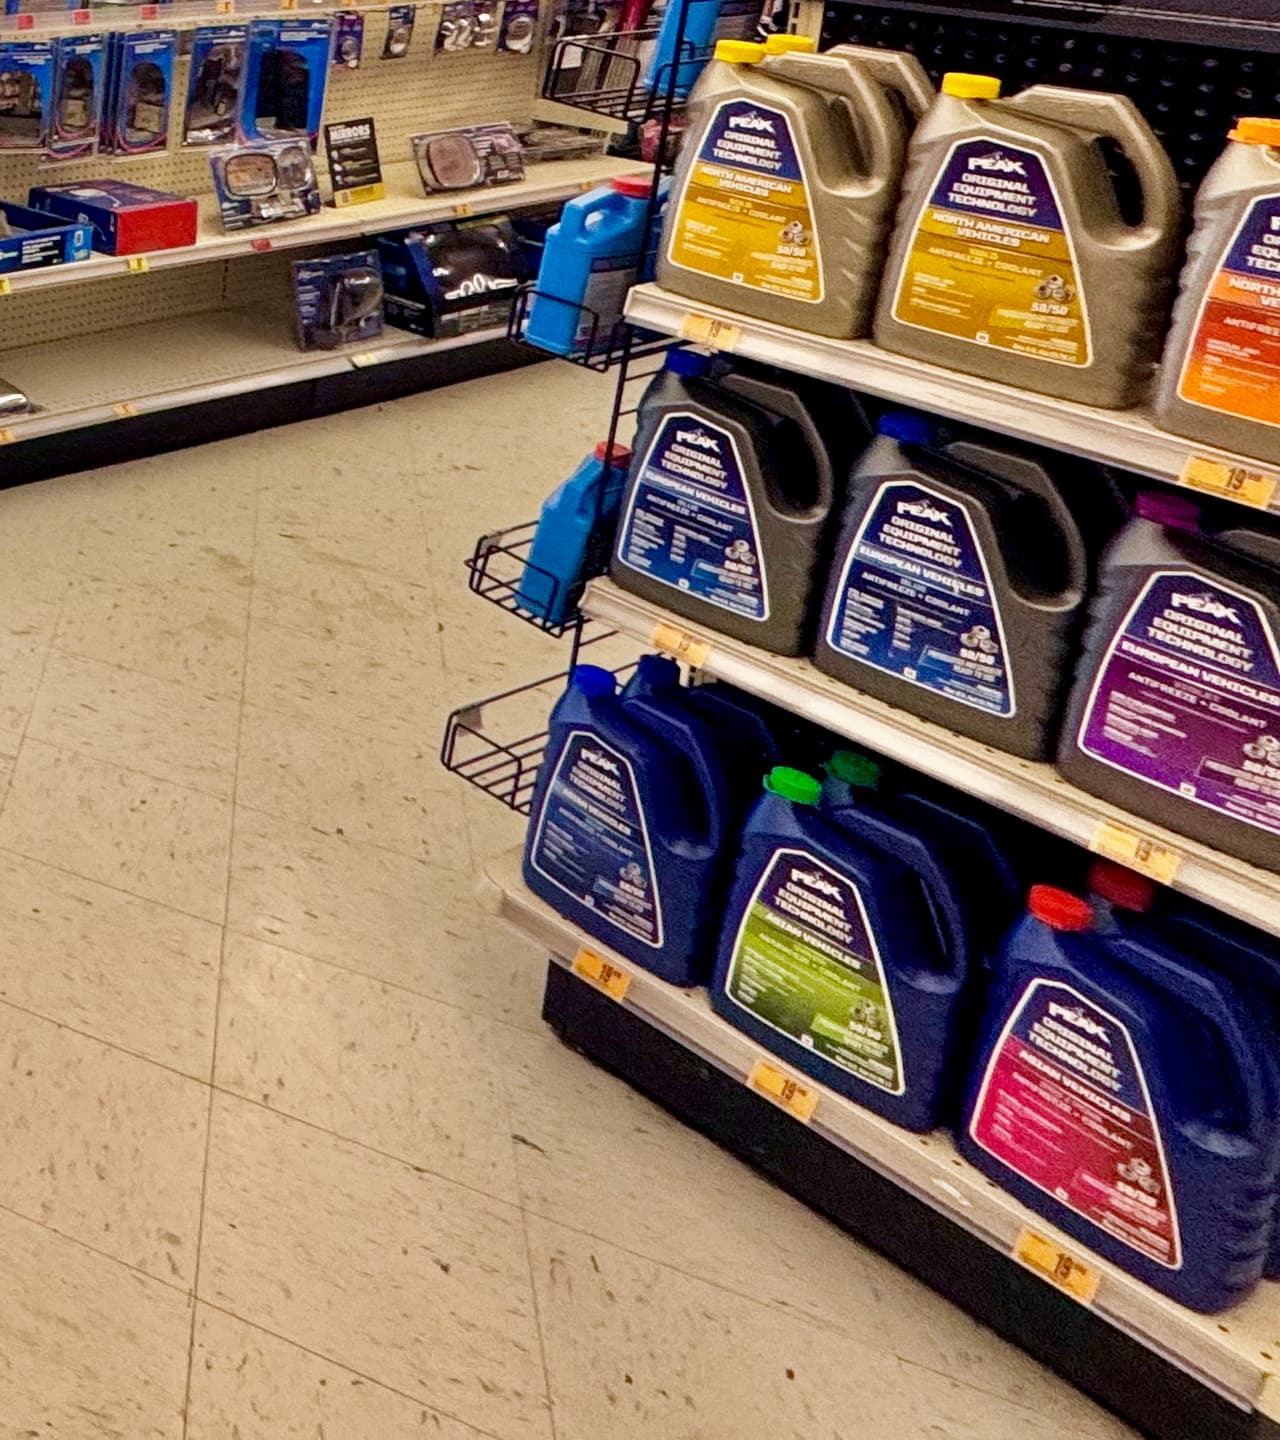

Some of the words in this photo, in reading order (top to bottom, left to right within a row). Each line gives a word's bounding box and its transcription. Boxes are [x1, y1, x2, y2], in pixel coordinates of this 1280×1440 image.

[724, 130, 777, 150] ORIGINAL
[729, 115, 777, 135] PEAK
[713, 148, 782, 170] TECHNOLOGY
[716, 139, 782, 160] EQUIPMENT
[968, 156, 1028, 177] PEAK
[700, 166, 734, 181] NORTH
[734, 173, 792, 193] AMERICAN
[719, 179, 769, 197] VEHICLES
[952, 183, 1038, 205] EQUIPMENT
[961, 173, 1030, 194] ORIGINAL
[947, 192, 1038, 217] TECHNOLOGY
[933, 212, 976, 228] NORTH
[976, 220, 1050, 243] AMERICAN
[956, 228, 1021, 247] VEHICLES
[671, 443, 723, 468] ORIGINAL
[676, 430, 722, 455] PEAK
[661, 458, 728, 489] TECHNOLOGY
[664, 451, 727, 479] EQUIPMENT
[645, 471, 695, 496] EUROPEAN
[695, 490, 746, 515] VEHICLES
[891, 515, 955, 544] ORIGINAL
[897, 501, 953, 527] PEAK
[878, 532, 962, 568] TECHNOLOGY
[882, 524, 962, 556] EQUIPMENT
[859, 546, 922, 575] EUROPEAN
[923, 568, 986, 597] VEHICLES
[861, 571, 916, 597] ANTIFREEZE
[924, 594, 970, 617] COOLANT
[1171, 592, 1243, 626] PEAK
[1153, 616, 1254, 658] EQUIPMENT
[1163, 609, 1246, 645] ORIGINAL
[1121, 640, 1200, 678] EUROPEAN
[1147, 626, 1255, 672] TECHNOLOGY
[1128, 671, 1198, 704] ANTIFREEZE
[1209, 703, 1268, 729] COOLANT
[786, 881, 847, 920] ORIGINAL
[791, 868, 845, 903] PEAK
[774, 895, 854, 944] TECHNOLOGY
[778, 887, 853, 932] EQUIPMENT
[765, 911, 803, 937] ASIAN
[803, 930, 862, 970] VEHICLES
[1042, 1015, 1115, 1065] ORIGINAL
[1048, 1001, 1112, 1046] PEAK
[1029, 1030, 1123, 1093] TECHNOLOGY
[1033, 1021, 1122, 1079] EQUIPMENT
[1019, 1049, 1061, 1082] ASIAN
[1062, 1072, 1132, 1123] VEHICLES
